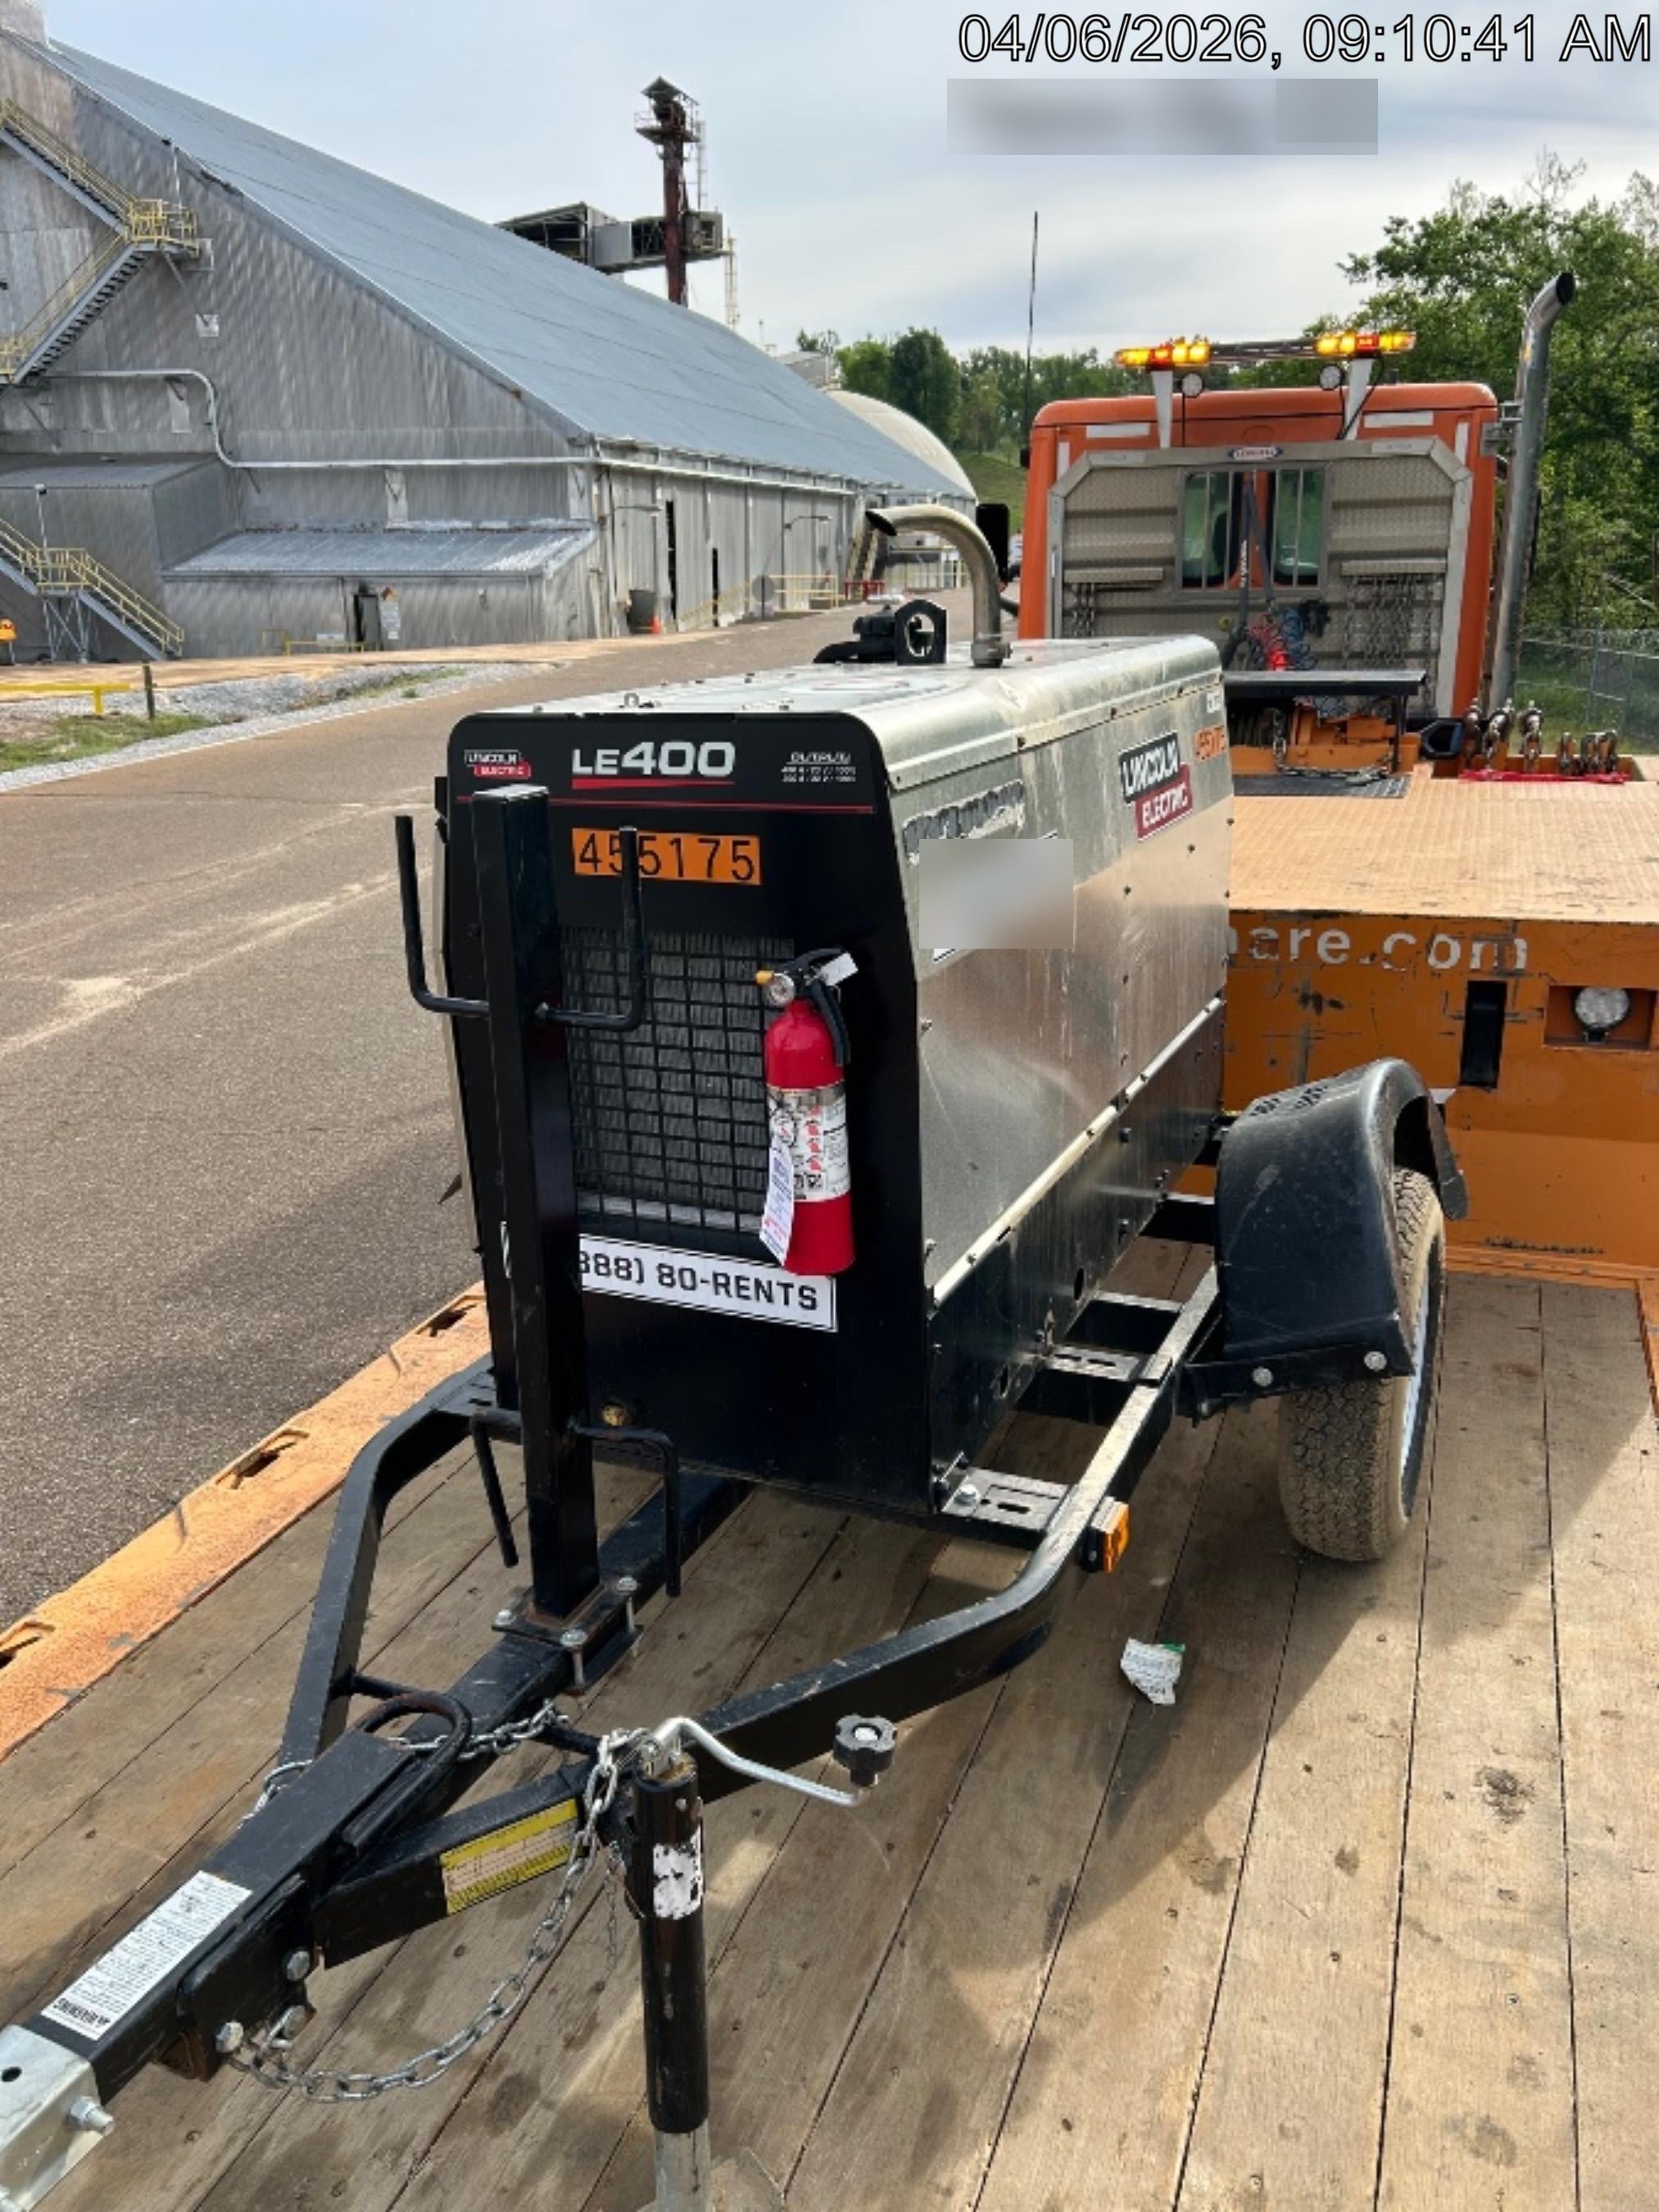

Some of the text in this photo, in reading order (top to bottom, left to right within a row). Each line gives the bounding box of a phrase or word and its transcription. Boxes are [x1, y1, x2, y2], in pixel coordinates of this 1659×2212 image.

[572, 741, 736, 777] LE400
[1122, 740, 1179, 798] LINCOLN
[1142, 782, 1189, 830] ELECTRIC
[578, 832, 756, 882] 455175
[656, 1262, 818, 1311] 80-RENTS
